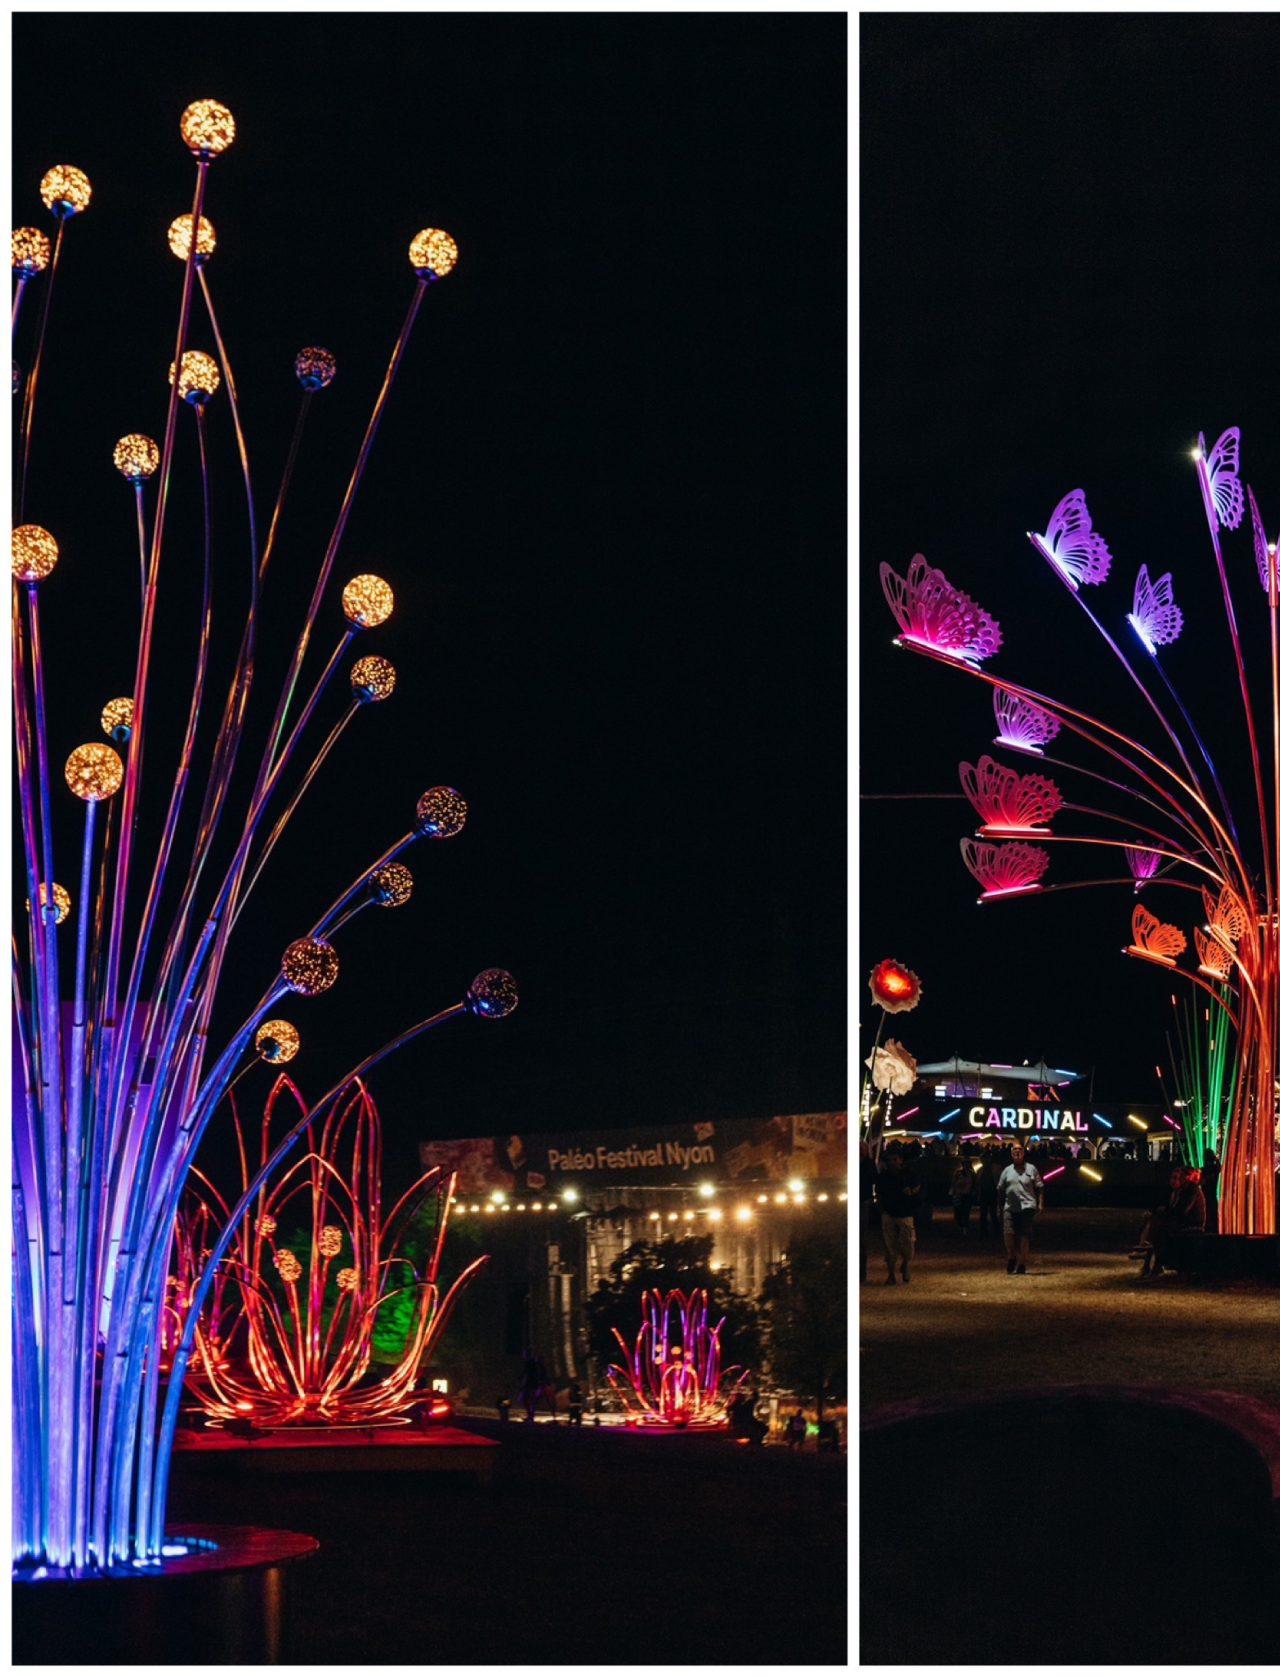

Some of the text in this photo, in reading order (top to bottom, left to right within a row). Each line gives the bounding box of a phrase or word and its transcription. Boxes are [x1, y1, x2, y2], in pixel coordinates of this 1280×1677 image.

[969, 1107, 1089, 1131] CARDINAL
[548, 1142, 715, 1171] Paléo Festival Nyon
